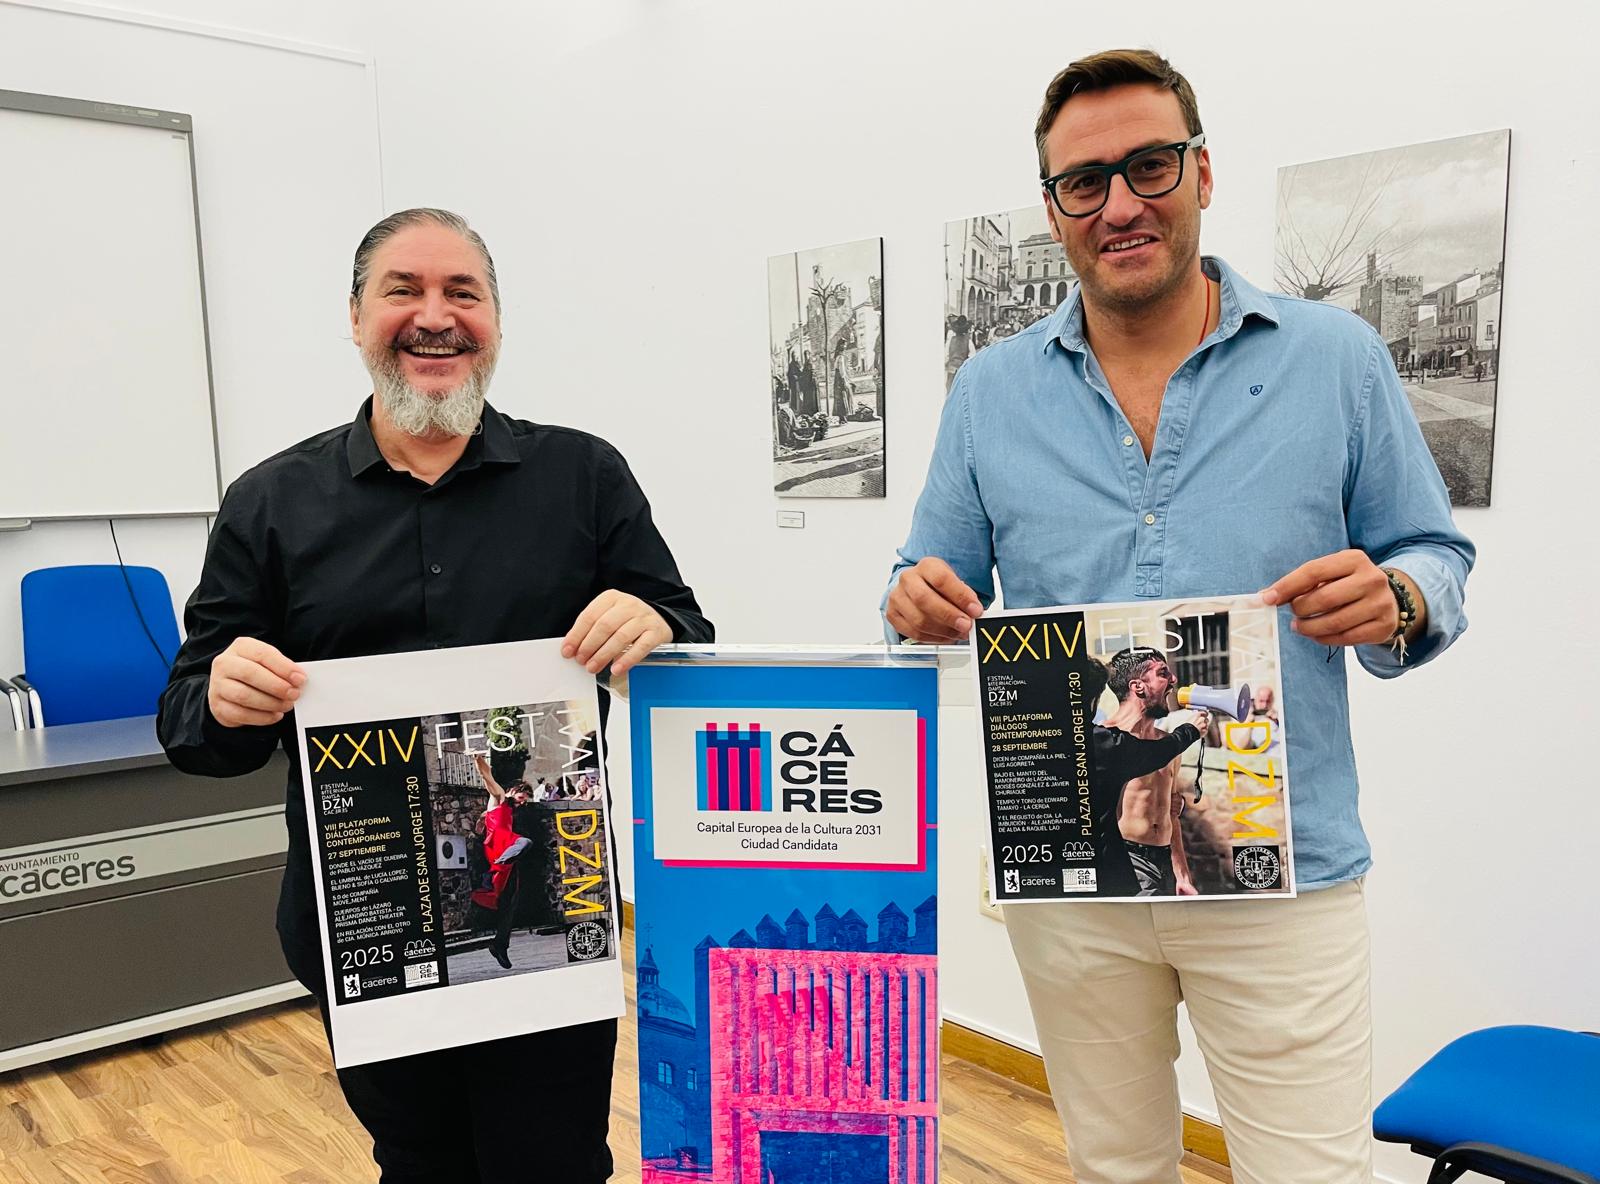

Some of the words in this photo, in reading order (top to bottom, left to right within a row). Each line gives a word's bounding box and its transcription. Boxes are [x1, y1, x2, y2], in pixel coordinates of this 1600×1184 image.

[980, 621, 1082, 664] XXIV
[989, 690, 1017, 702] DZM
[1069, 672, 1082, 706] 17:30
[991, 723, 1027, 731] DIÁLOGOS
[1003, 713, 1053, 722] PLATAFORMA
[991, 729, 1062, 740] CONTEMPORÁNEOS
[1072, 708, 1084, 750] JORGE
[311, 726, 418, 772] XXIV
[780, 724, 855, 757] CÁ
[1003, 742, 1048, 751] SEPTIEMBRE
[780, 760, 848, 785] CE
[1077, 752, 1088, 777] SAN
[1078, 779, 1089, 795] DE
[1226, 721, 1279, 838] DZM
[406, 776, 421, 808] 17:30
[782, 789, 882, 814] RES
[323, 797, 353, 810] DZM
[339, 816, 391, 829] PLATAFORMA
[1080, 796, 1092, 836] PLAZA
[326, 828, 365, 839] DIÁLOGOS
[326, 832, 400, 847] CONTEMPORÁNEOS
[411, 810, 425, 849] JORGE
[697, 822, 735, 835] Capital
[737, 823, 782, 836] Europea
[785, 823, 798, 834] de
[801, 824, 810, 834] la
[813, 824, 852, 835] Cultura
[855, 825, 881, 835] 2031
[339, 845, 386, 858] SEPTIEMBRE
[741, 838, 779, 849] Ciudad
[782, 839, 838, 850] Candidata
[1002, 844, 1052, 863] 2025
[0, 852, 80, 872] AYUNTAMIENTO
[416, 852, 428, 876] SAN
[556, 810, 605, 916] DZM
[418, 877, 430, 893] DE
[421, 894, 434, 932] PLAZA
[341, 944, 394, 970] 2025
